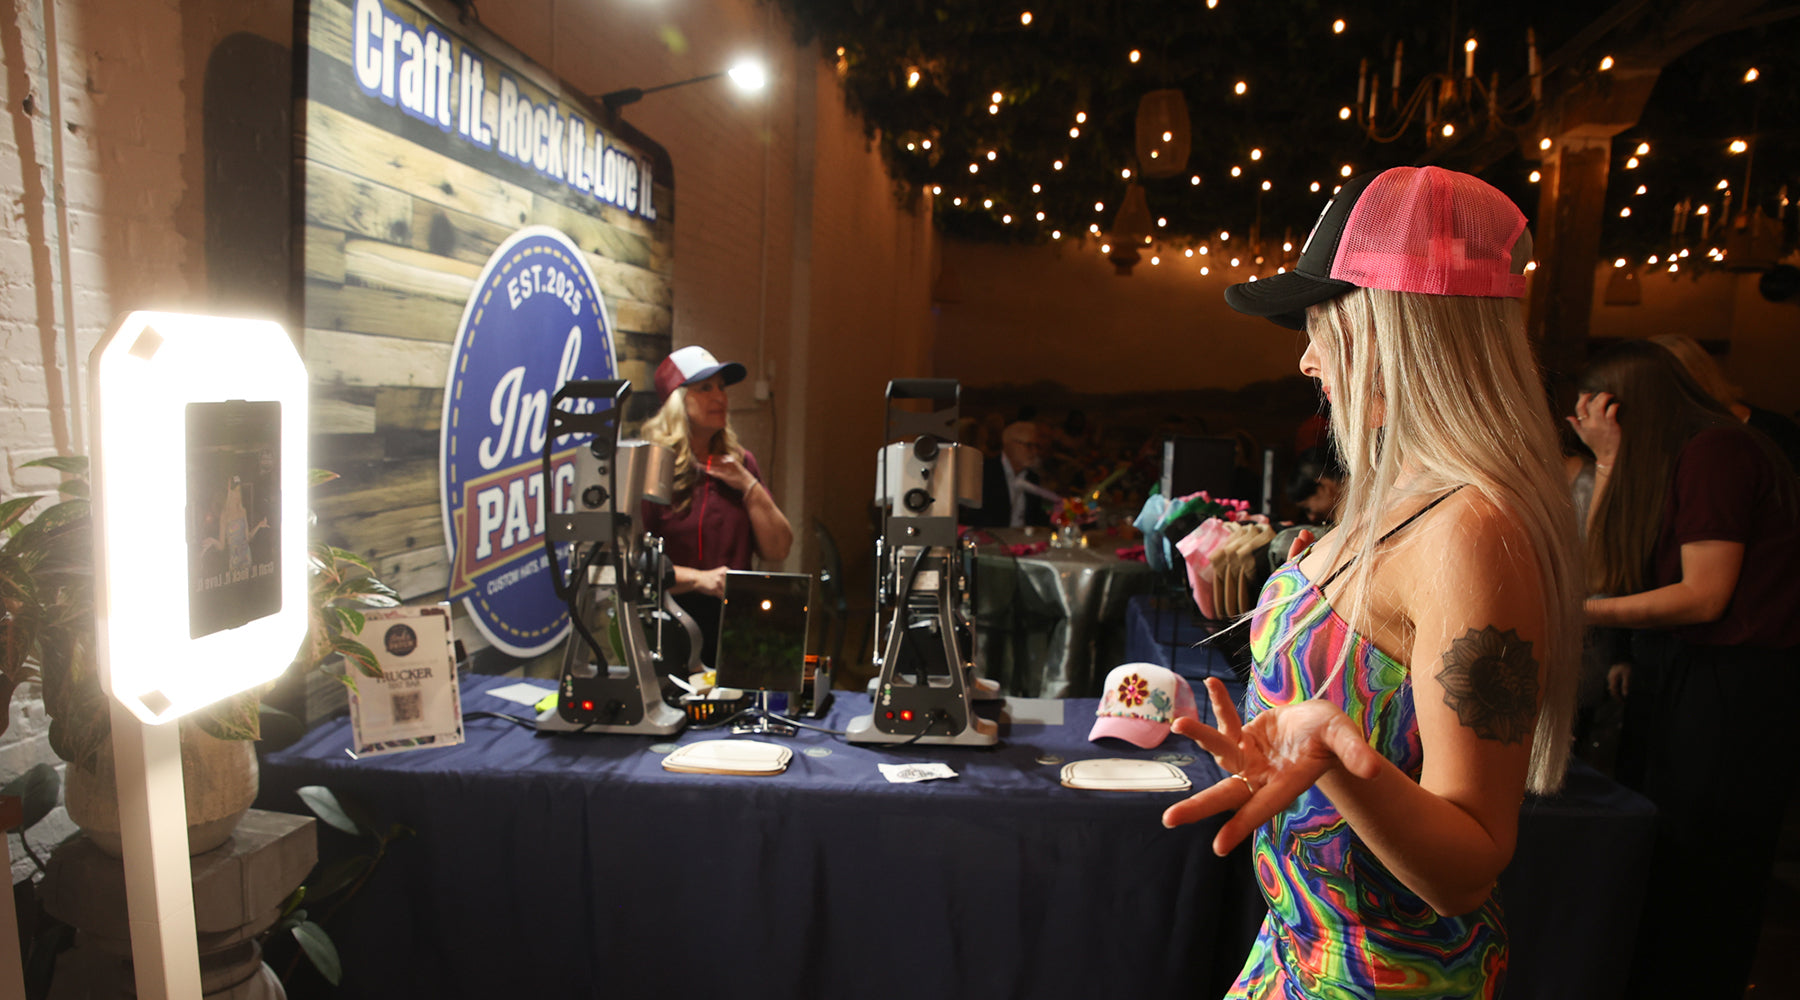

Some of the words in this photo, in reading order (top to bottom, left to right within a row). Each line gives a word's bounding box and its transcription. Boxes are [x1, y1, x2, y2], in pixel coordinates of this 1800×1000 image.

[354, 0, 453, 128] Craft
[458, 50, 492, 147] It.
[498, 75, 565, 181] Rock
[567, 116, 591, 192] It.
[594, 132, 638, 212] Love
[507, 264, 583, 316] EST.2025
[475, 462, 576, 561] PATC
